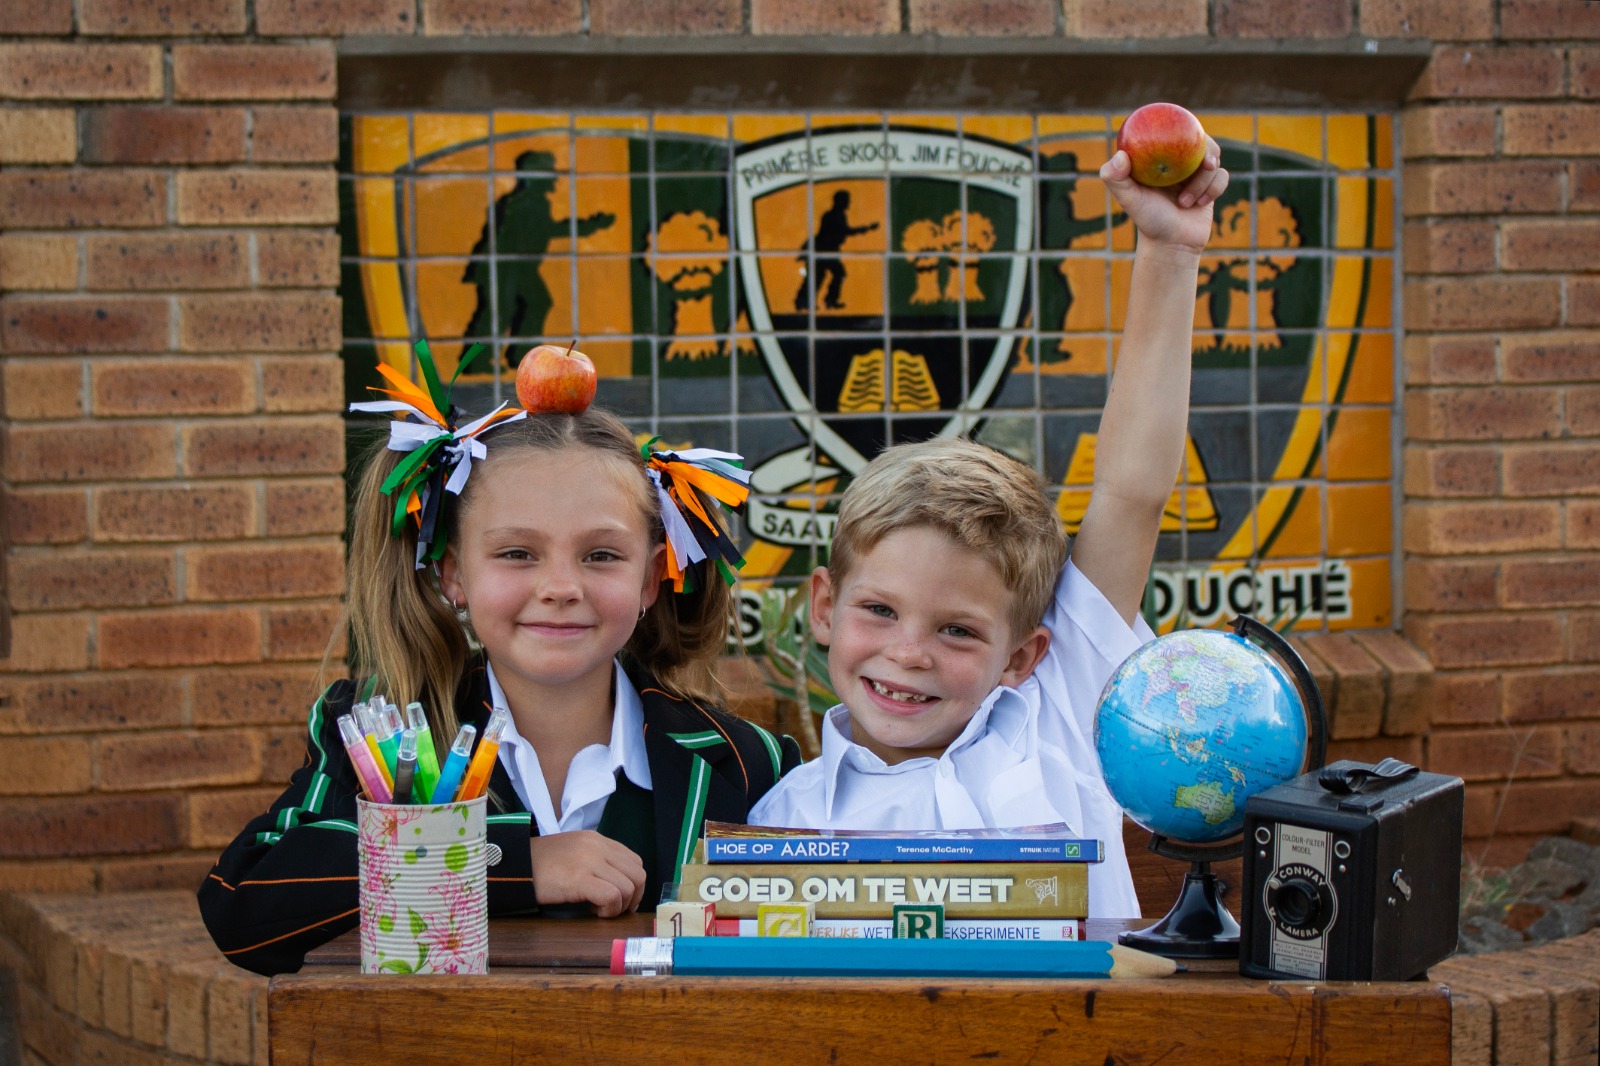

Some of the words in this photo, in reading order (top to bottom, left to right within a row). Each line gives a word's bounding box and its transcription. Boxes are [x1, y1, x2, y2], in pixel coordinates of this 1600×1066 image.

[838, 142, 903, 164] SKOOL
[911, 144, 940, 164] JIM
[716, 843, 747, 854] HOE
[752, 843, 774, 854] OP
[781, 841, 850, 857] AARDE?
[896, 846, 930, 854] Terence
[932, 846, 973, 855] McCarthy
[1292, 844, 1311, 855] MODEL
[1279, 866, 1327, 887] CONWAY
[699, 877, 794, 902] GOED
[802, 877, 855, 902] OM
[862, 877, 906, 902] TE
[913, 877, 1014, 902] WEET
[815, 926, 860, 938] ERLIKE
[863, 927, 894, 938] WET
[944, 926, 1041, 940] EKSPERIMENTE
[903, 913, 932, 938] R
